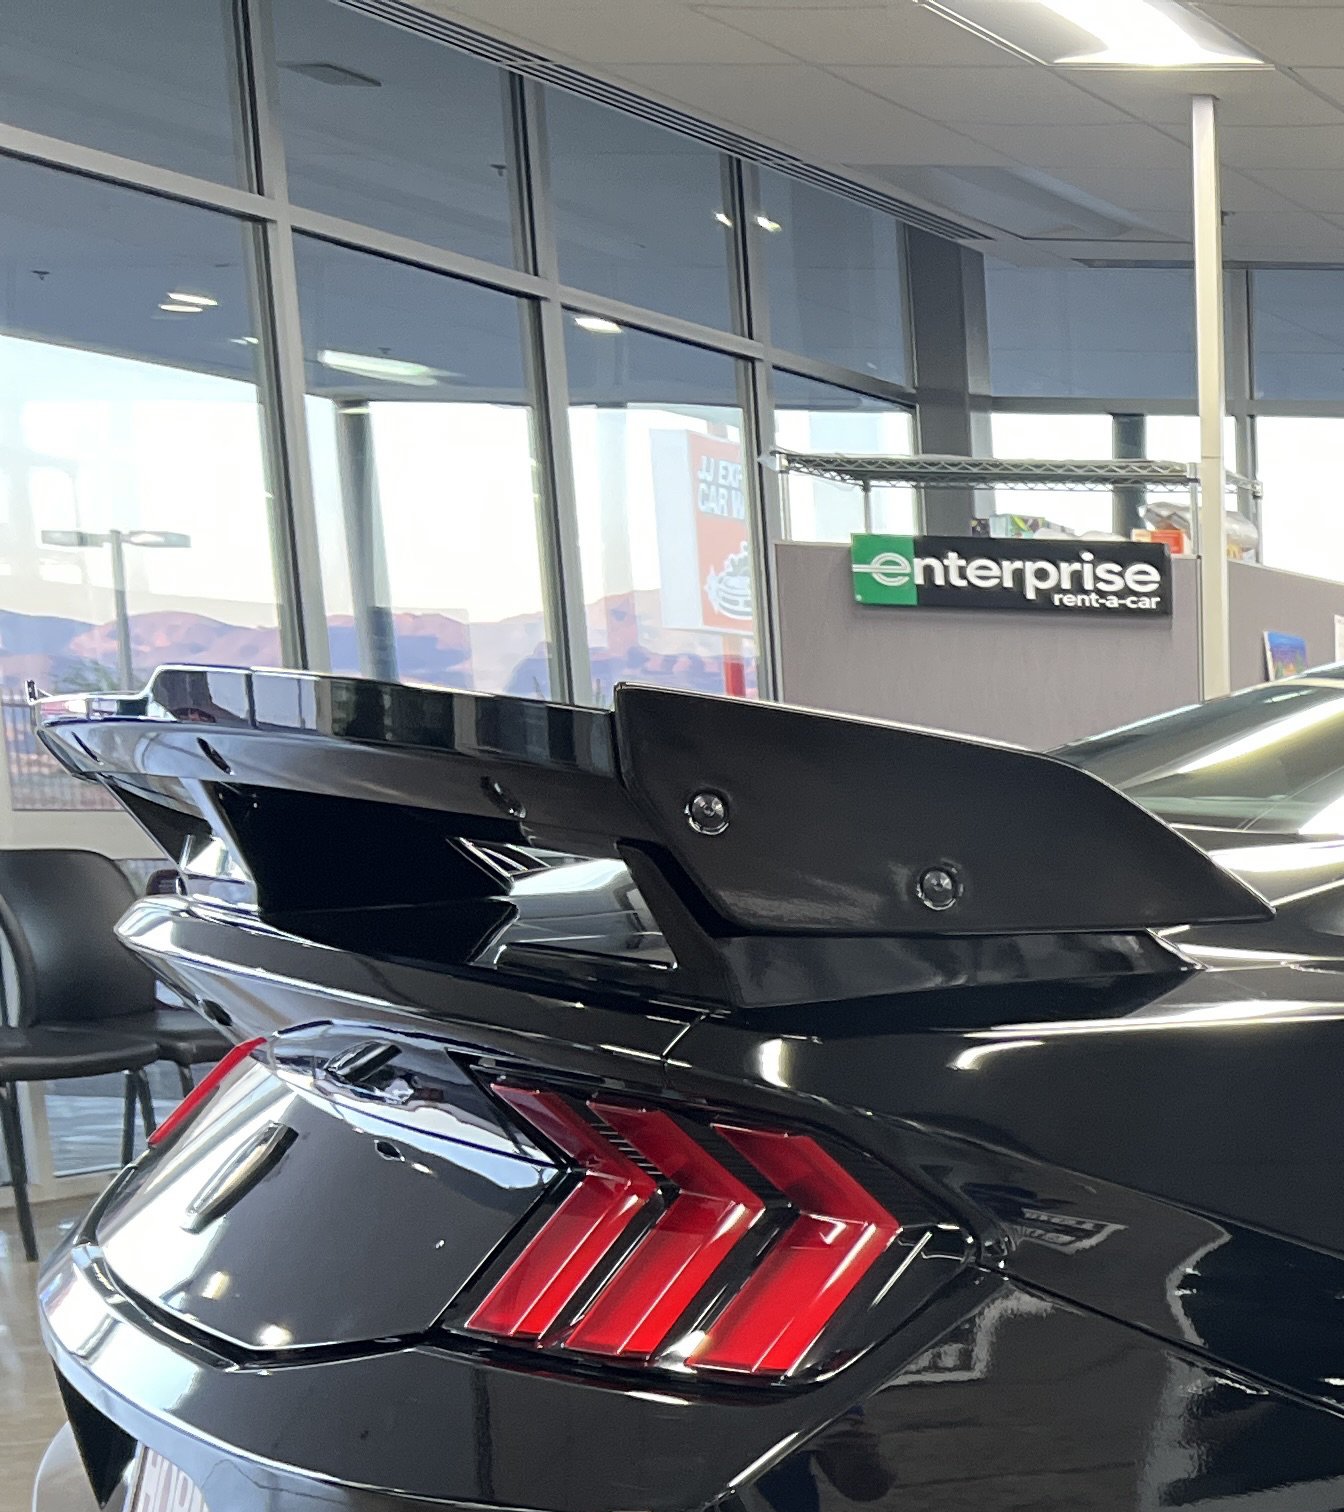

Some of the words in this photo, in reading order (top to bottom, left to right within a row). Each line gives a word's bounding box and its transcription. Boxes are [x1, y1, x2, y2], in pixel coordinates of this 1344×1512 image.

[698, 483, 729, 516] CAR
[853, 551, 1161, 600] enterprise
[1053, 592, 1161, 610] rent-a-car
